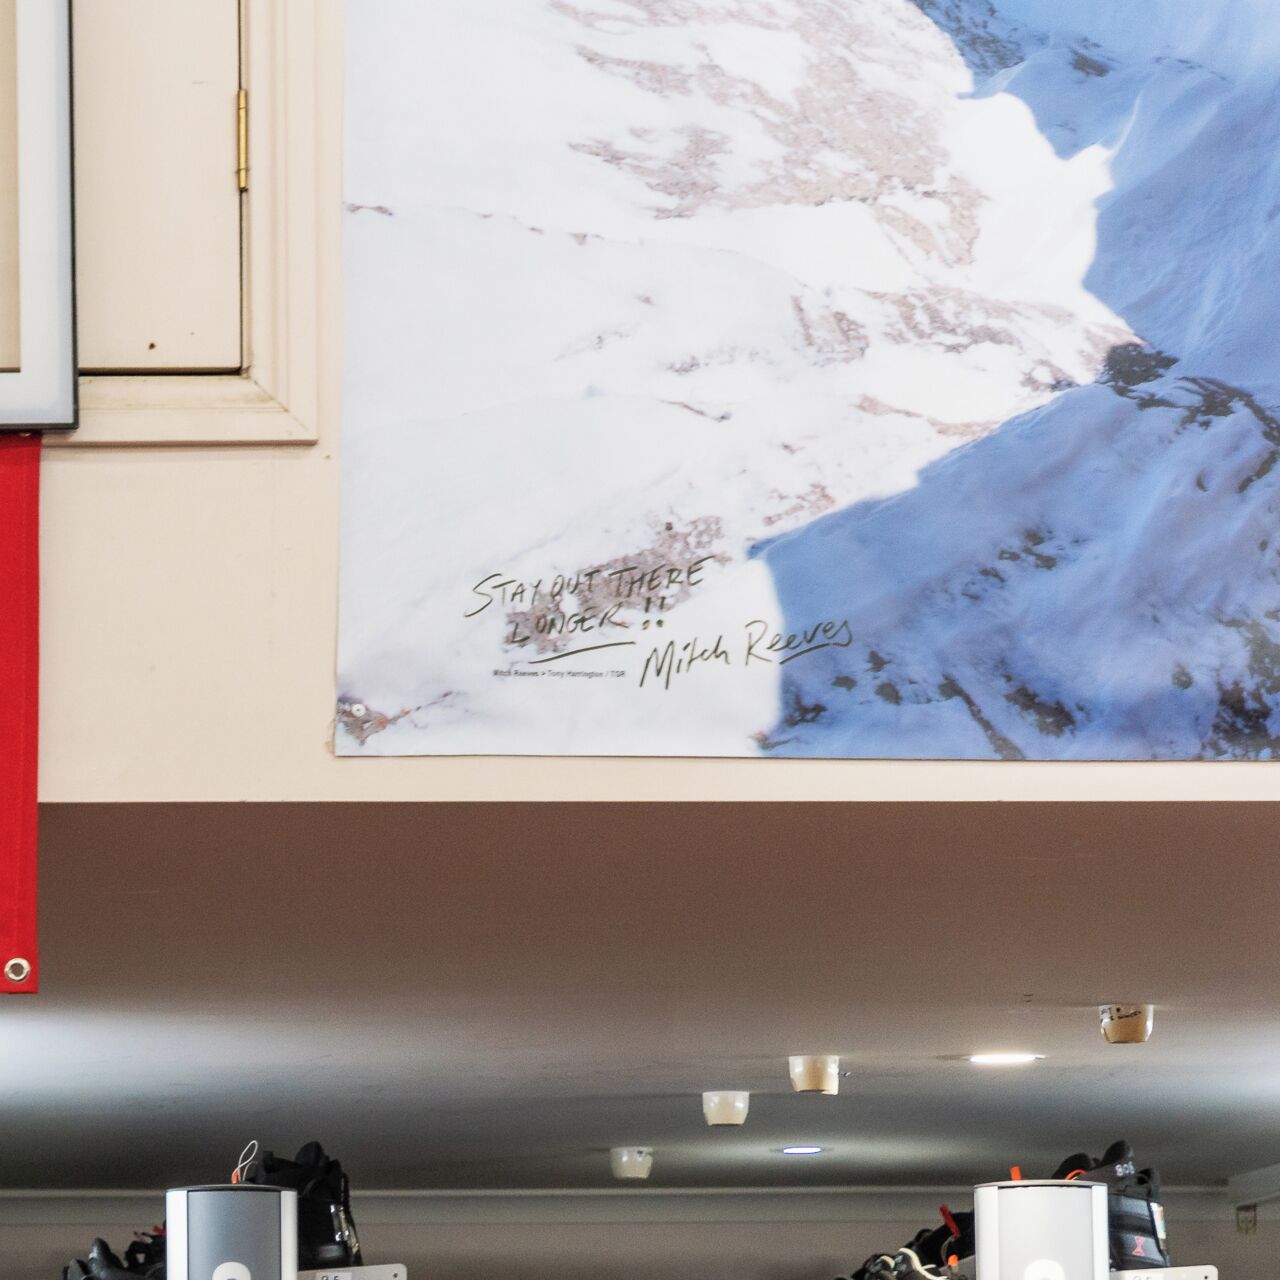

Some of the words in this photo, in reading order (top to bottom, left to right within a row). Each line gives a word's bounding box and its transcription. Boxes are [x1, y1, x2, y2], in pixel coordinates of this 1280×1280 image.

[464, 572, 542, 618] STAY
[549, 568, 602, 600] OUT
[606, 554, 717, 598] THERE
[509, 602, 632, 645] LONGER
[638, 632, 733, 691] Mitch
[743, 617, 855, 668] Reeves
